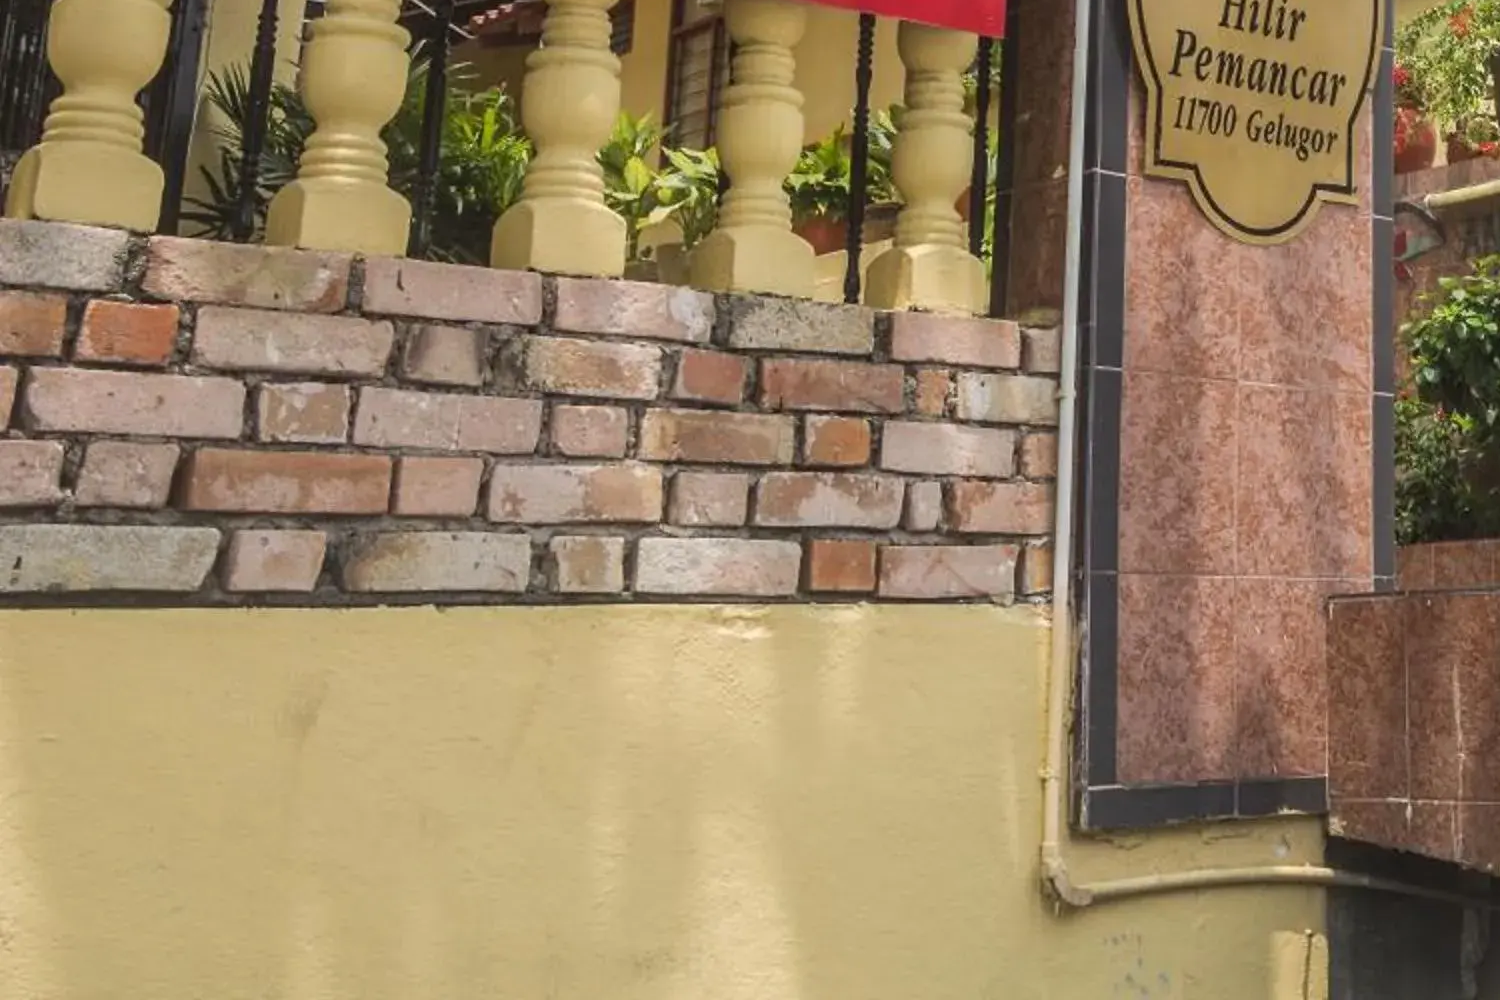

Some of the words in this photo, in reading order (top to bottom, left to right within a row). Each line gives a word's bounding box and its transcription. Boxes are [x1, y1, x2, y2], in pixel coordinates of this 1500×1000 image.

[1168, 29, 1347, 107] Pemancar
[1172, 95, 1238, 138] 11700
[1246, 109, 1339, 161] Gelugor
